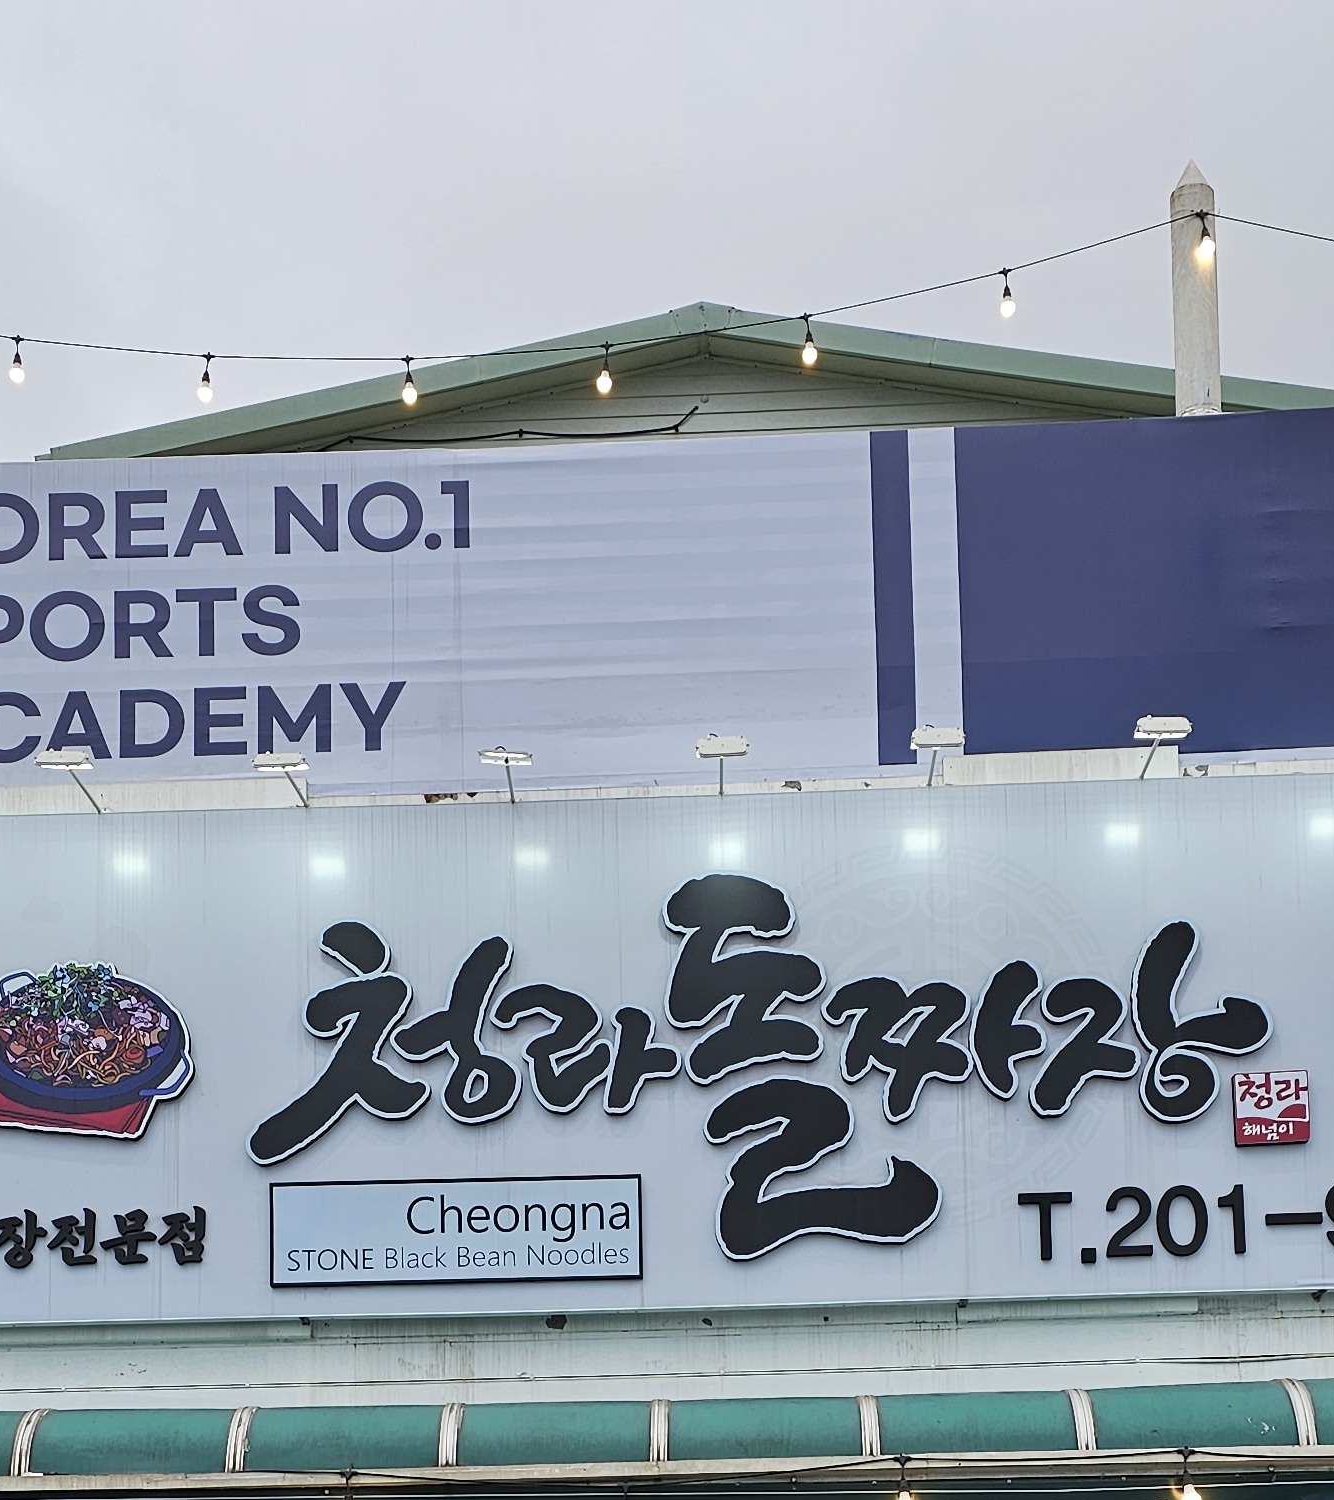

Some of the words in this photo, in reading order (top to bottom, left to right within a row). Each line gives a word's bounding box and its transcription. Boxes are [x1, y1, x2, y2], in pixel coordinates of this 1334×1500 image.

[274, 479, 472, 555] NO.1
[247, 872, 1273, 1263] 청라돌짜장
[1238, 1072, 1308, 1110] 청라
[1242, 1121, 1294, 1141] 해넘이
[406, 1194, 632, 1243] Cheongna
[286, 1247, 375, 1273] STONE
[383, 1244, 447, 1271] Black
[455, 1244, 518, 1269] Bean
[526, 1243, 630, 1267] Noodles
